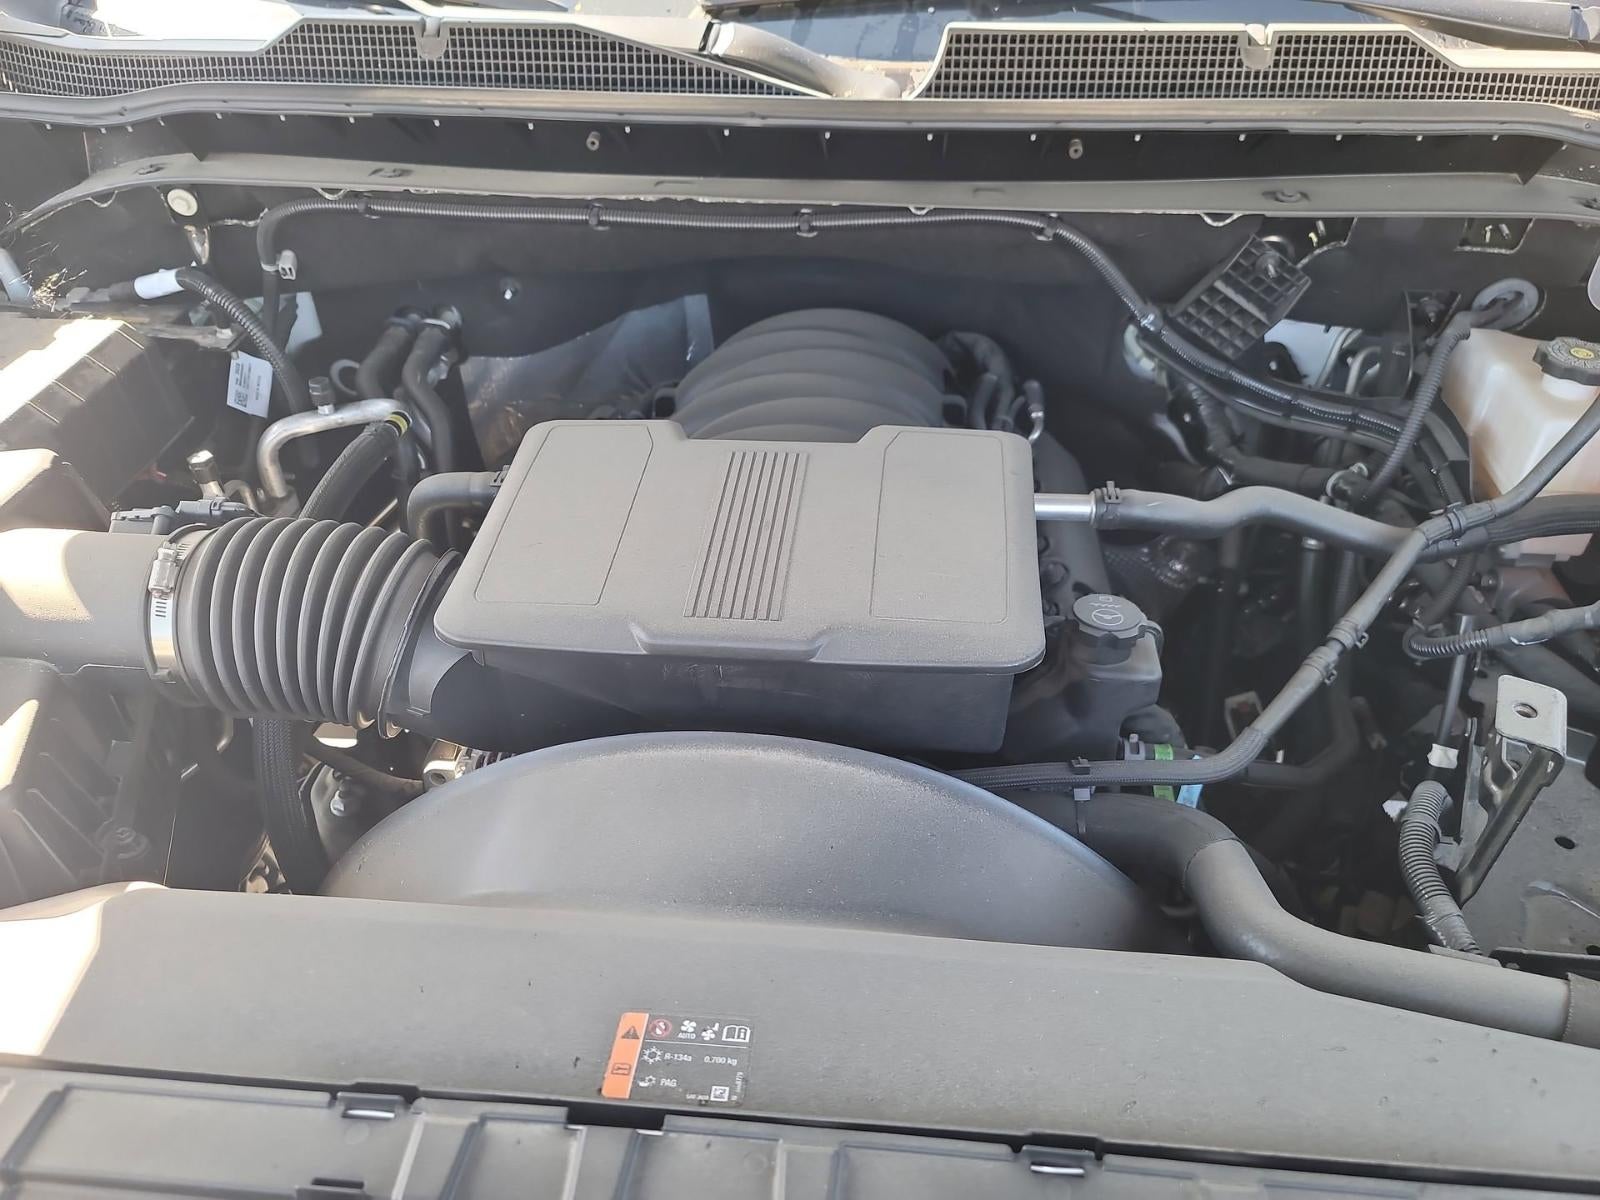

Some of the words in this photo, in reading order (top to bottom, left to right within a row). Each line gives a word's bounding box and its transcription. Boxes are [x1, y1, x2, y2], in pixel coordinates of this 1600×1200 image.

[677, 1032, 696, 1040] AUTO
[664, 1052, 692, 1062] R-134a
[704, 1055, 726, 1064] 0.700
[728, 1056, 738, 1066] kg
[660, 1078, 677, 1087] PAG
